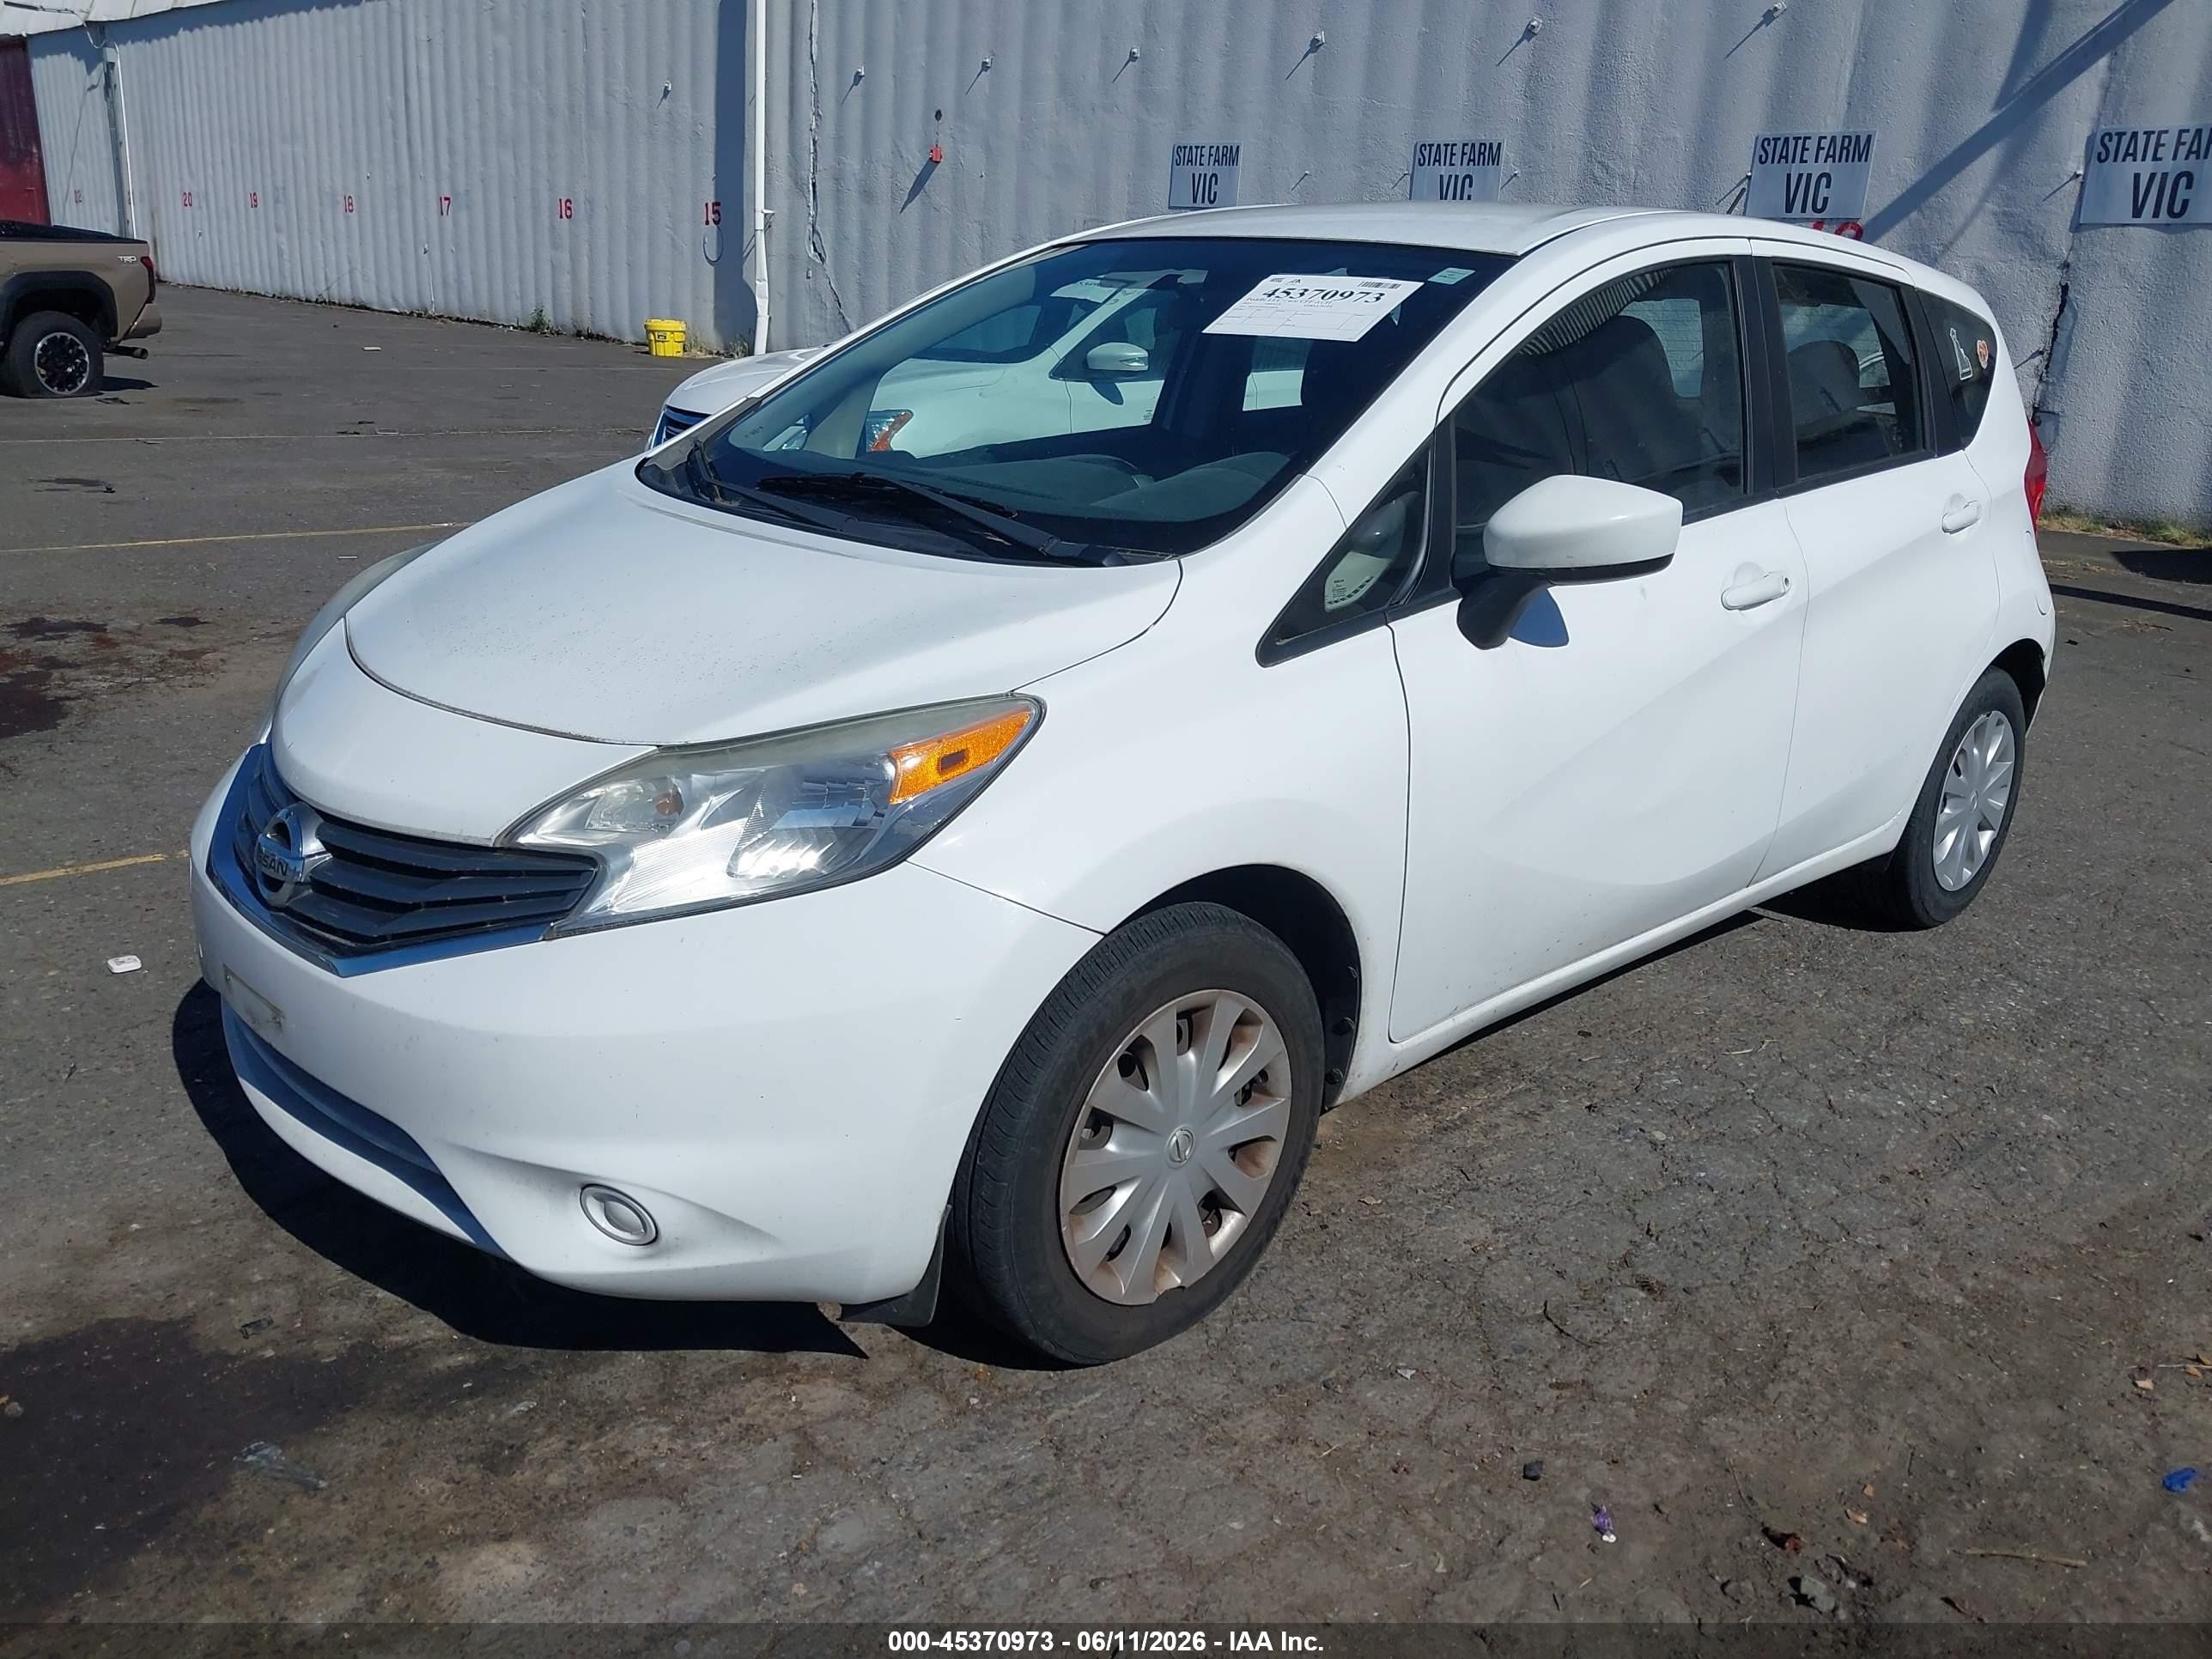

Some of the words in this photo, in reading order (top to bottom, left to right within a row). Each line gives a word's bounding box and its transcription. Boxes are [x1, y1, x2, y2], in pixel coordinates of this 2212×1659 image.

[1175, 145, 1206, 167] STATE
[1207, 144, 1240, 167] FARM
[1417, 143, 1457, 167] STATE
[1460, 142, 1503, 167] FARM
[1758, 136, 1812, 165] STATE
[1814, 134, 1872, 164] FARM
[2097, 130, 2169, 164] STATE
[183, 191, 193, 207] 20
[1191, 173, 1218, 204] VIC
[1438, 174, 1474, 200] VIC
[1784, 172, 1832, 214] VIC
[2131, 171, 2195, 219] VIC
[250, 192, 258, 209] 19
[344, 196, 354, 214] 18
[440, 197, 452, 216] 17
[559, 198, 574, 220] 16
[704, 202, 722, 226] 15
[1263, 287, 1385, 303] 45370973
